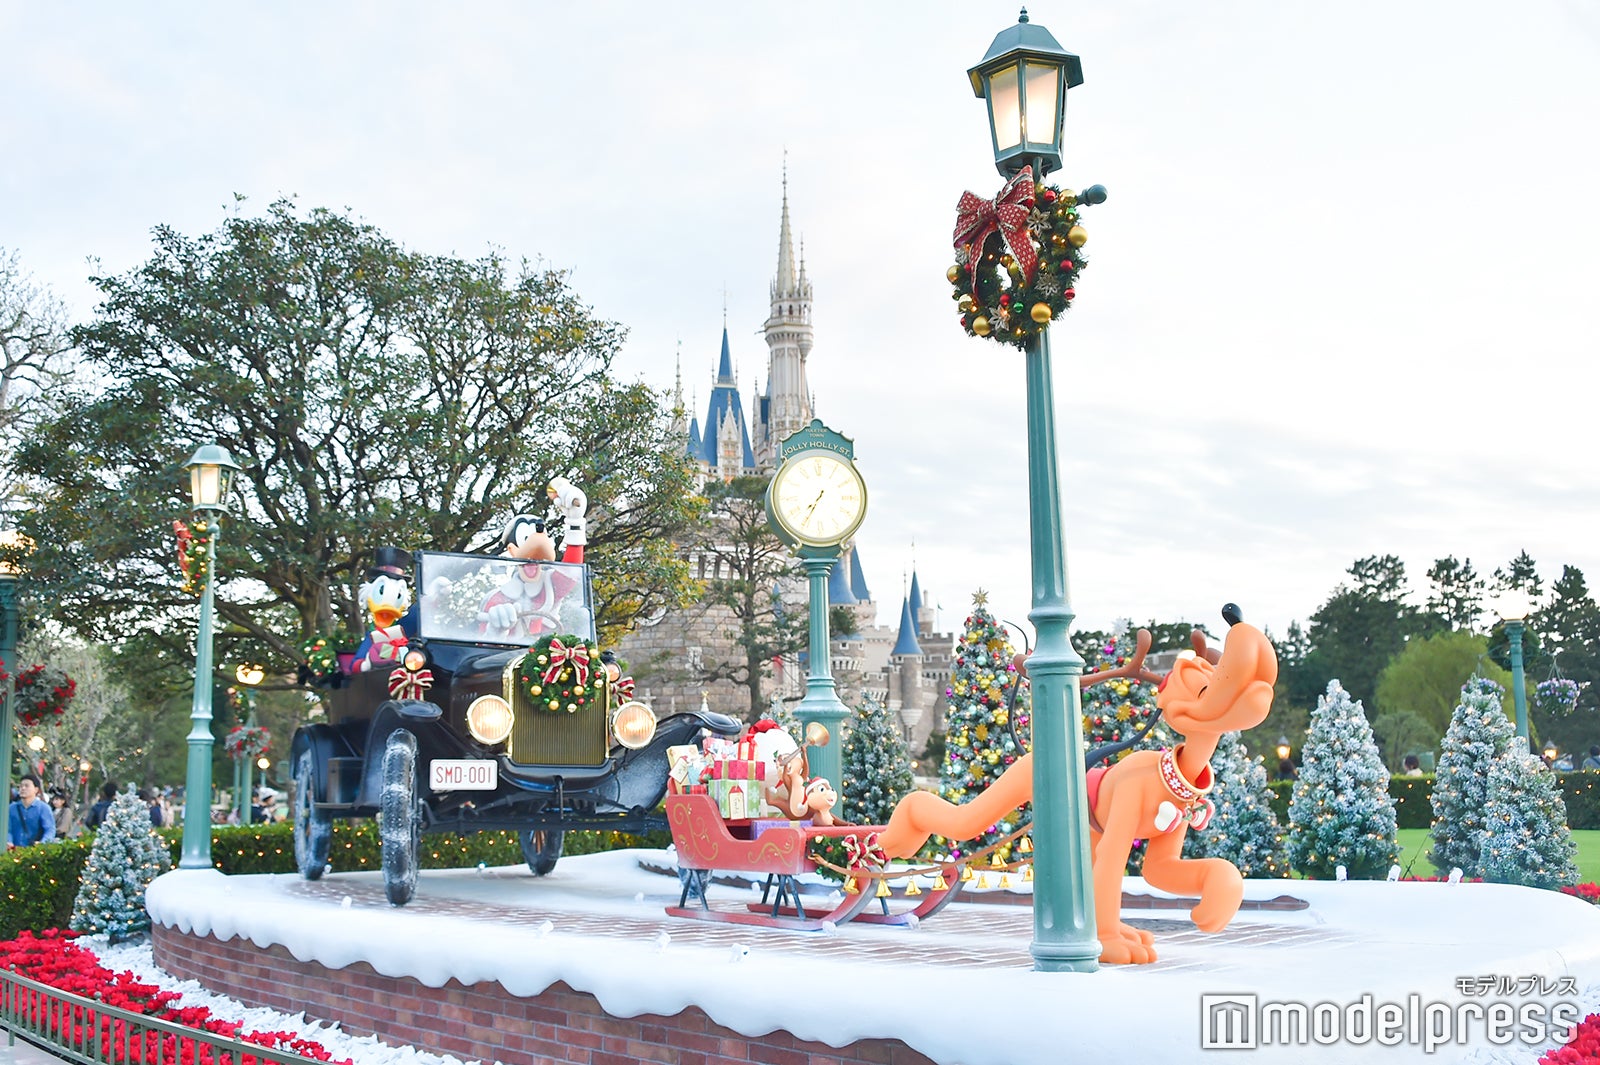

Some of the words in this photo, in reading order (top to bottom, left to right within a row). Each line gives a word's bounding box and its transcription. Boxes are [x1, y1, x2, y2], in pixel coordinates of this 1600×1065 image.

[783, 442, 808, 456] JOLLY
[809, 441, 839, 451] HOLLY
[839, 446, 851, 457] ST.
[436, 766, 491, 784] SMD-001
